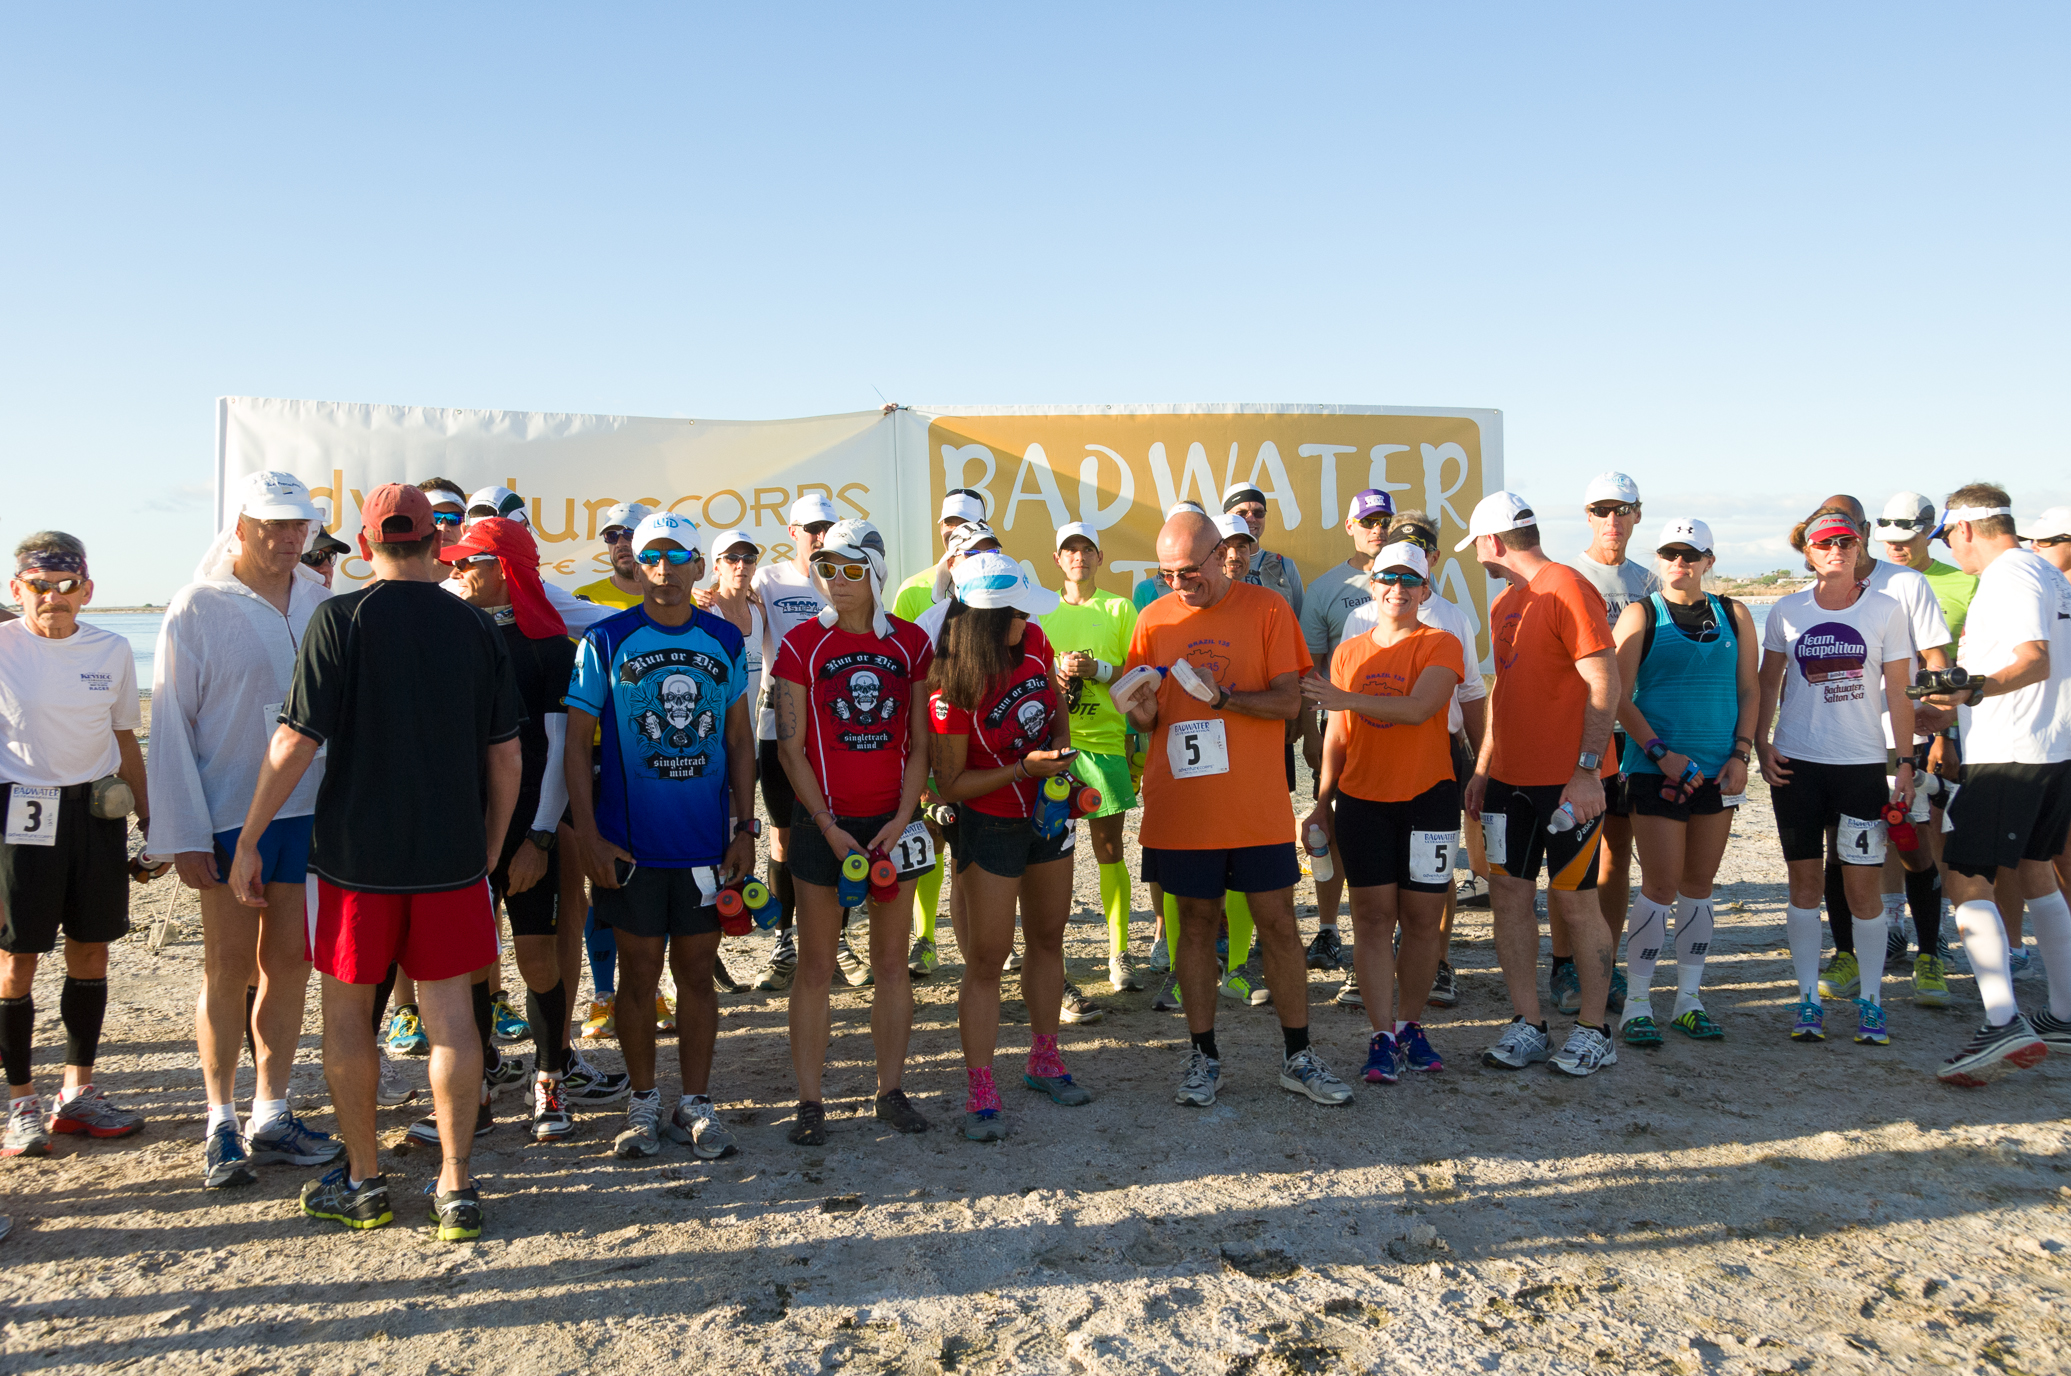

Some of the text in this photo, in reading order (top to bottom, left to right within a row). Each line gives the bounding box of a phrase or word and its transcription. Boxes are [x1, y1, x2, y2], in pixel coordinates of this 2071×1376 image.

[940, 440, 1469, 533] BADWATER
[1341, 595, 1371, 609] Team
[1187, 639, 1231, 649] BRAZIL 135
[1803, 633, 1835, 646] Team
[1798, 641, 1865, 659] Neapolitan
[628, 652, 719, 677] Run or Die
[825, 654, 898, 674] Run or Die
[1823, 683, 1866, 696] Badwater:
[989, 678, 1046, 722] Run or Die
[1823, 691, 1864, 704] Salton Sea
[1174, 721, 1210, 733] BADWATER
[843, 733, 889, 745] singletrack
[856, 742, 877, 750] mind
[1184, 734, 1201, 766] 5
[653, 755, 707, 769] singletrack
[669, 767, 695, 778] mind
[13, 786, 60, 797] BADWATER
[23, 800, 42, 832] 3
[1581, 819, 1595, 835] asics
[1424, 833, 1456, 841] BADWATER
[1855, 829, 1869, 855] 4
[898, 835, 928, 870] 13
[1434, 844, 1448, 873] 5
